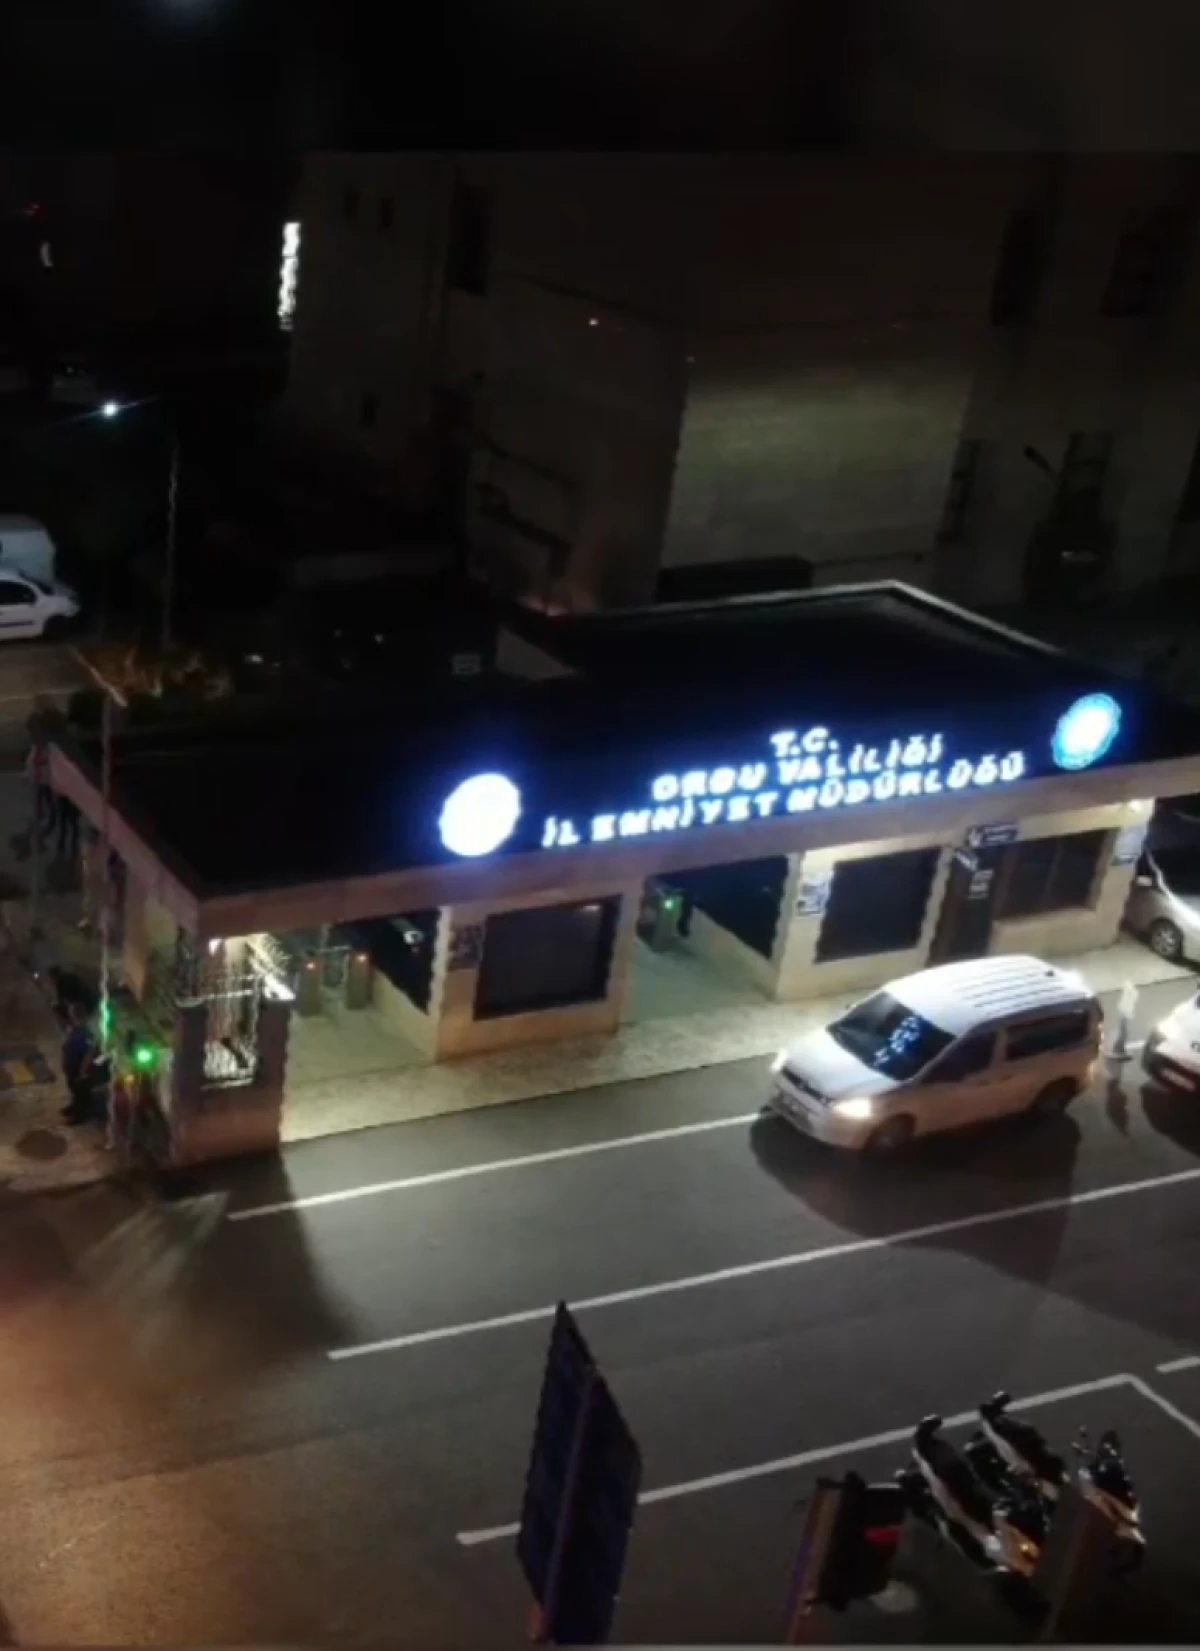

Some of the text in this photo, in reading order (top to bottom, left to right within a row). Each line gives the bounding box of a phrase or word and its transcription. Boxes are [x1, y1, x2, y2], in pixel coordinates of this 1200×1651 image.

[541, 751, 1024, 848] İL EMNİYET MÜDÜRLÜĞÜ
[652, 761, 767, 801] ORDU
